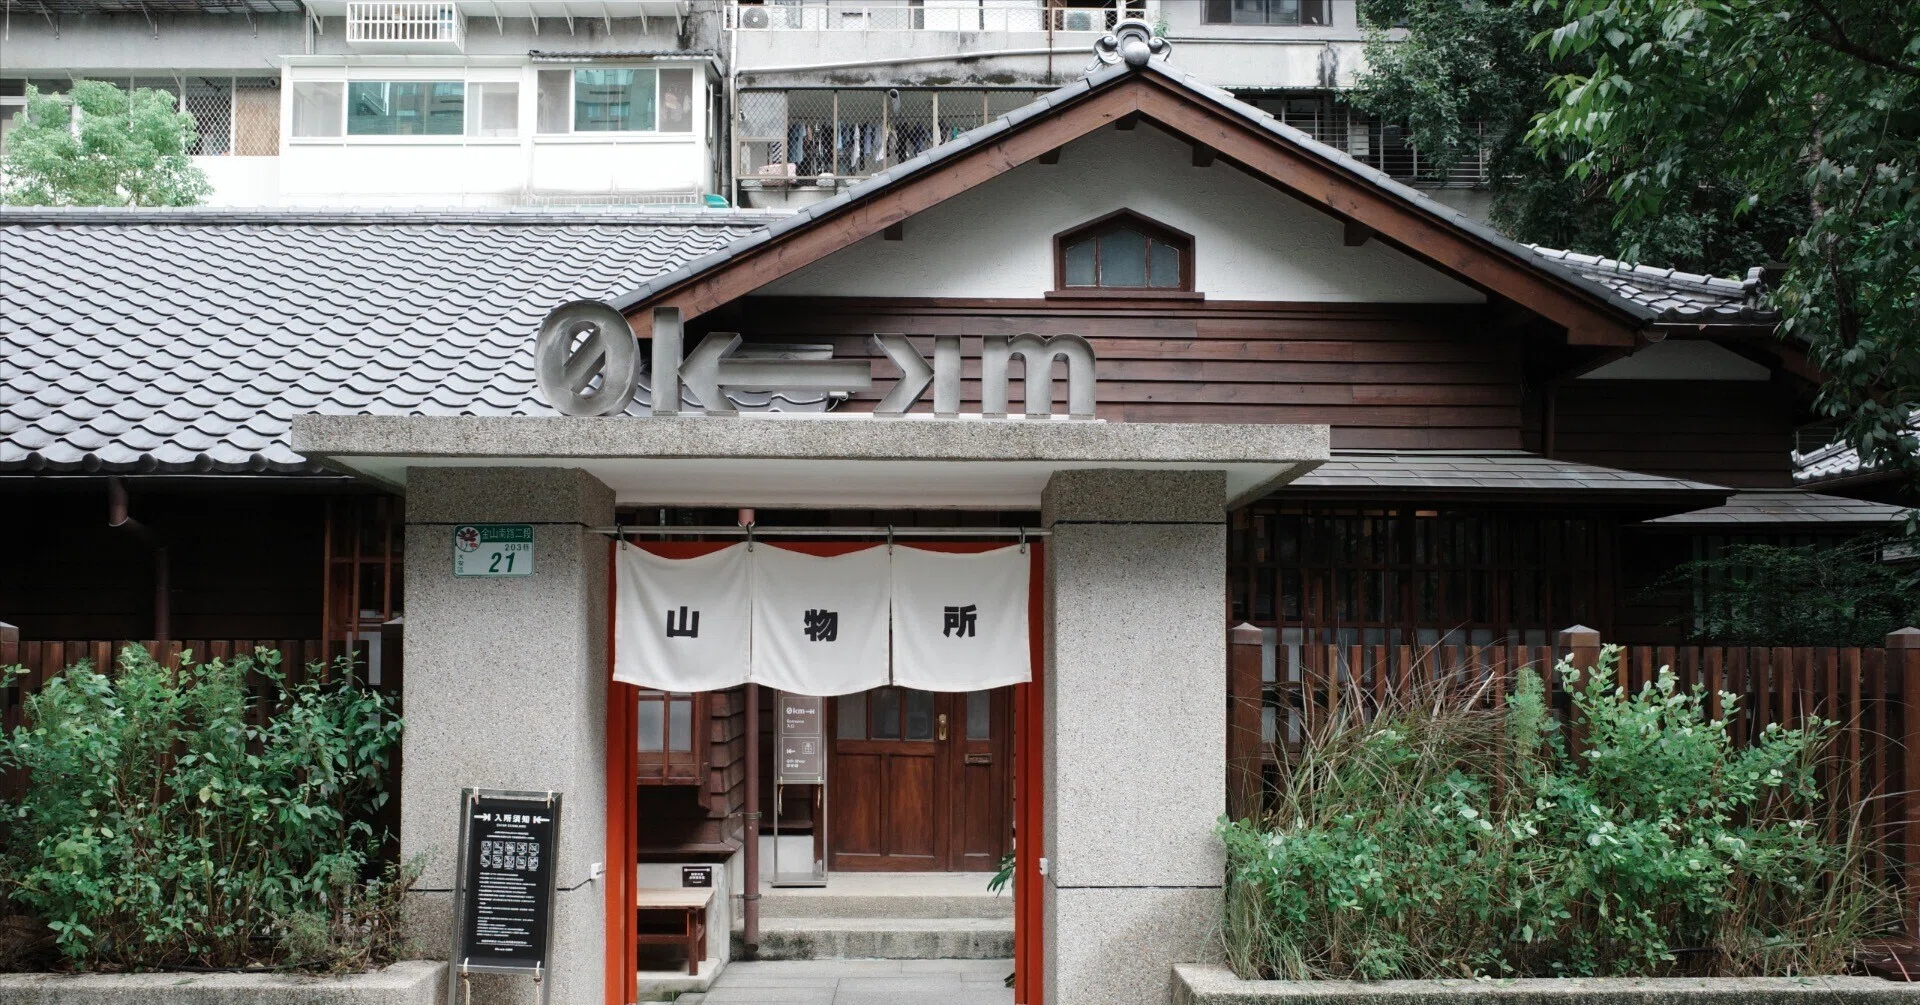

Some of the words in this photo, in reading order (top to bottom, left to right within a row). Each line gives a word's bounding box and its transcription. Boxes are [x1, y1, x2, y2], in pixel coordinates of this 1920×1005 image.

[481, 527, 531, 539] 金山南路二段
[488, 551, 516, 573] 21
[494, 813, 530, 824] 入所須知
